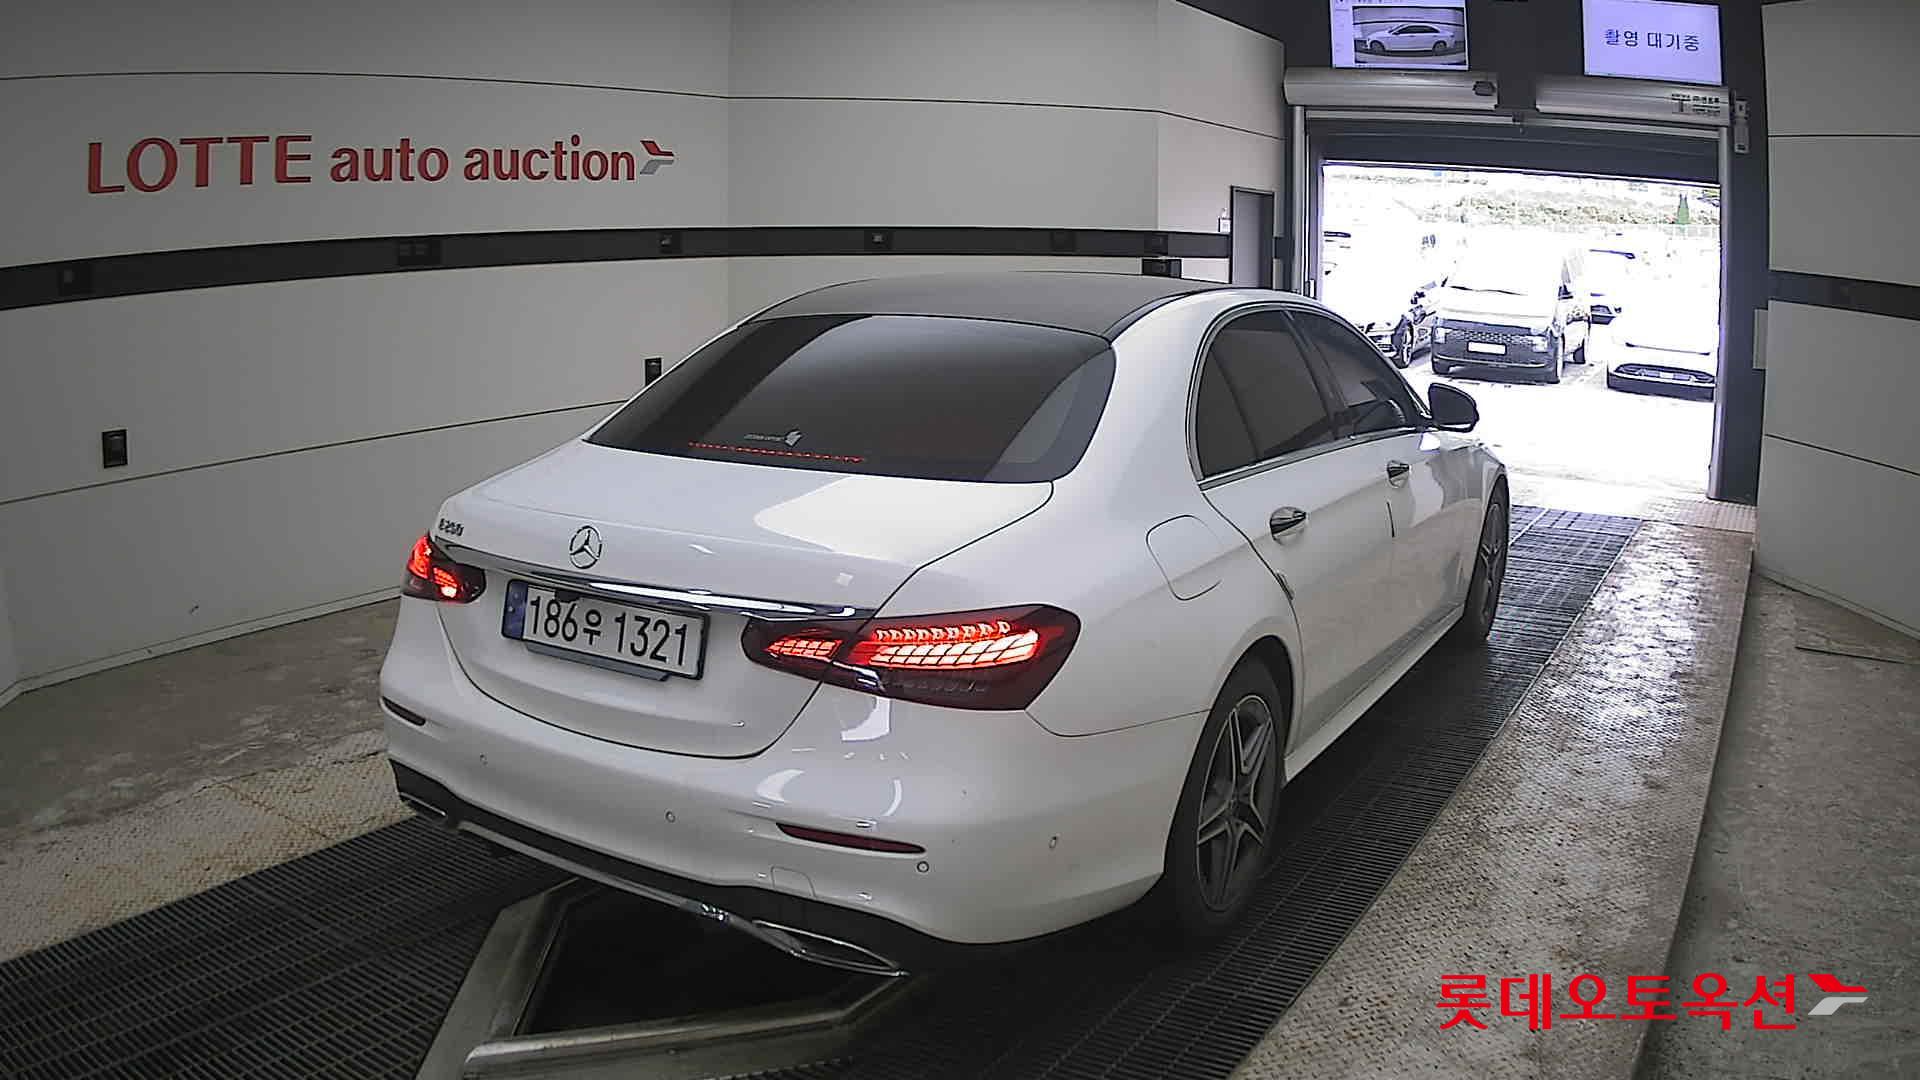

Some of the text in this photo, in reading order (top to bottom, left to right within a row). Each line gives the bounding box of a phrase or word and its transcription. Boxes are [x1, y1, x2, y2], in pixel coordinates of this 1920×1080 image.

[1647, 32, 1700, 52] 대기중
[87, 134, 636, 194] LOTTE auto auction
[529, 595, 688, 666] 186우 1321
